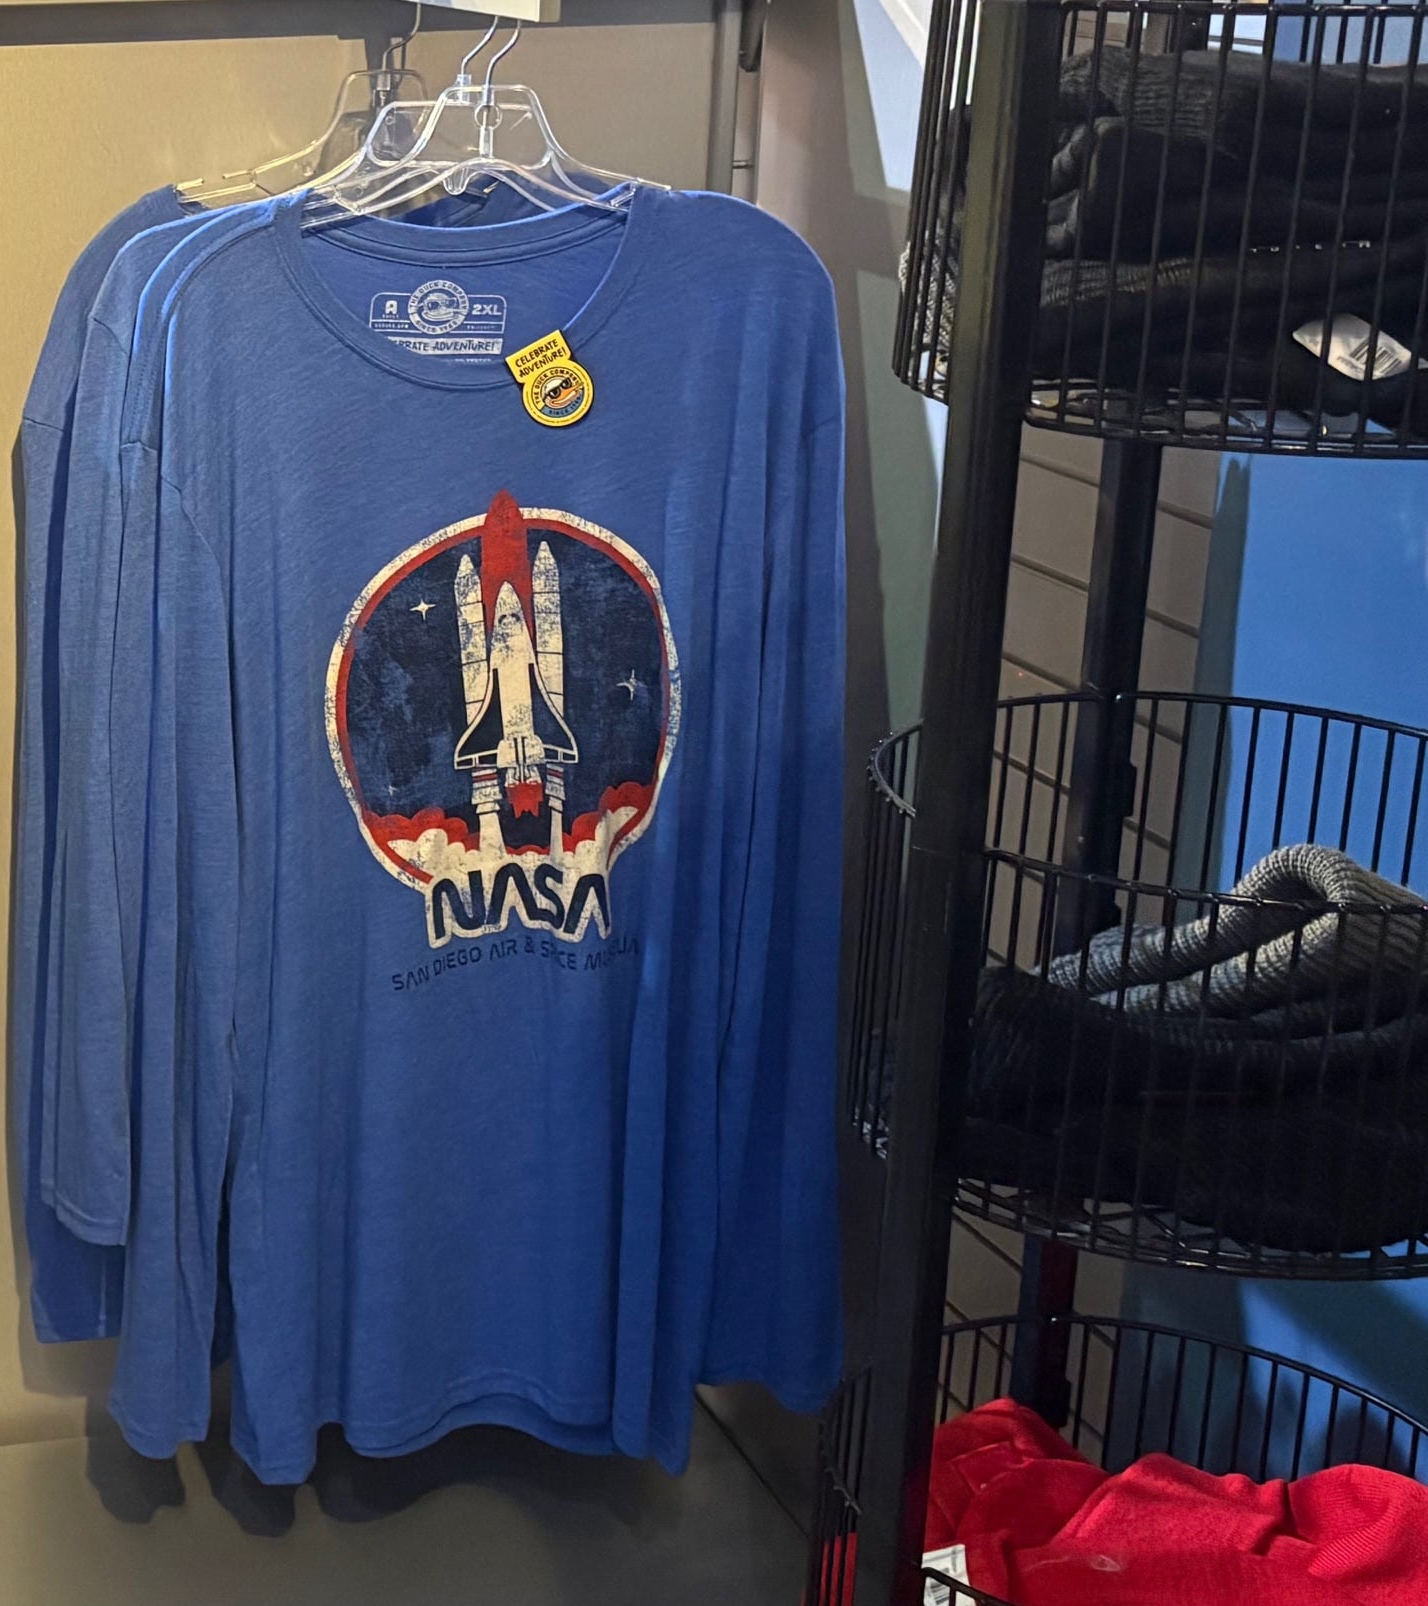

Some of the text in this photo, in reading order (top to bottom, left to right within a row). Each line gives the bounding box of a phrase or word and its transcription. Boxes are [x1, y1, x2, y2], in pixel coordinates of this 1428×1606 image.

[471, 303, 502, 315] 2XL
[432, 339, 495, 352] ADVENTURE!
[515, 338, 559, 368] CELEBRATE
[518, 346, 568, 378] ADVENTURE!
[431, 862, 611, 940] NASA
[392, 965, 430, 991] SAN
[433, 946, 482, 977] DIEGO
[490, 939, 518, 961] AIR
[524, 935, 536, 954] &
[540, 940, 577, 971] SCE
